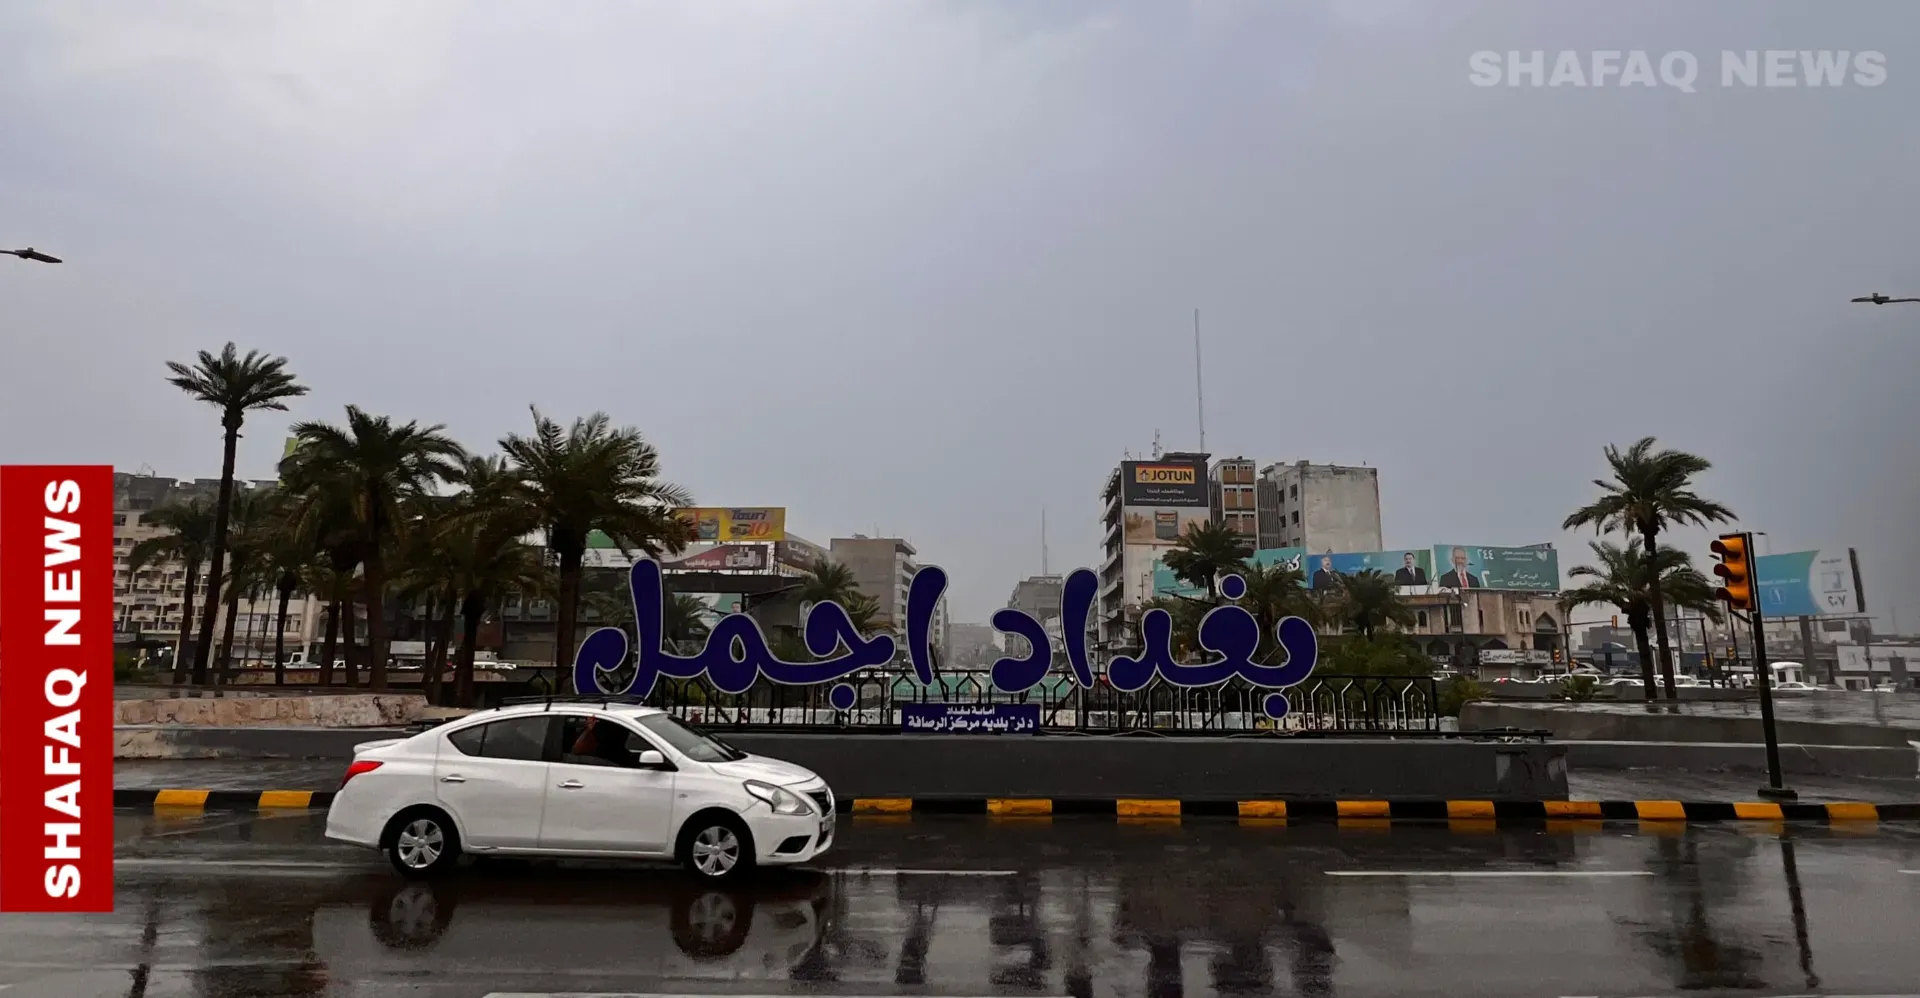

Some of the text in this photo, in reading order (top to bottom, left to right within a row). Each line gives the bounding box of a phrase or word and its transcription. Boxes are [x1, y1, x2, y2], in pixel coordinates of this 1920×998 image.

[1152, 471, 1192, 481] JOTUN
[573, 556, 1318, 720] بغداد اجمل
[946, 705, 995, 715] أمانة بغداد
[908, 715, 948, 731] الرصافة
[948, 716, 980, 731] مركز
